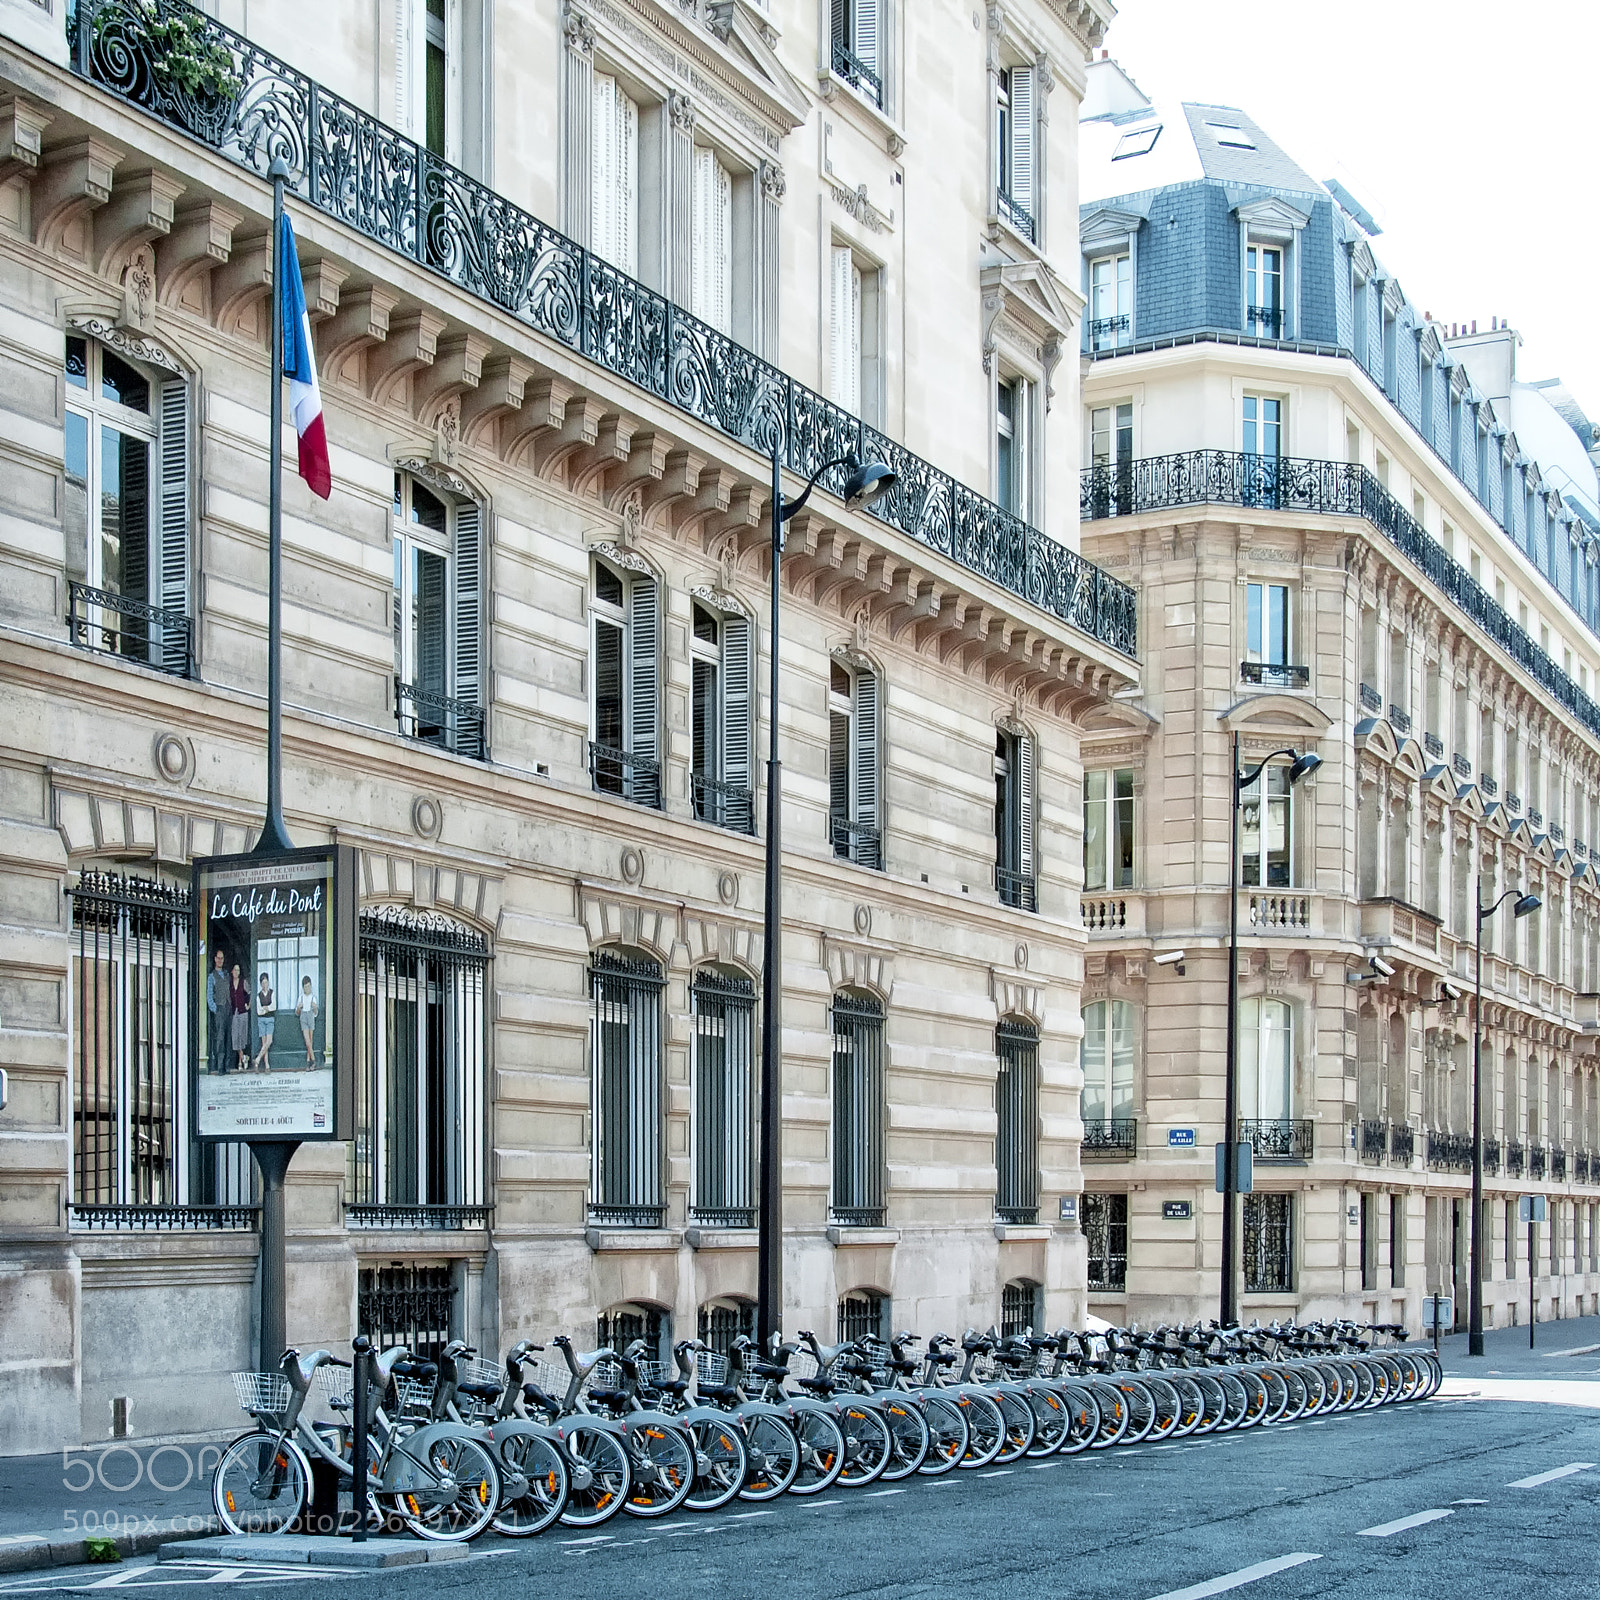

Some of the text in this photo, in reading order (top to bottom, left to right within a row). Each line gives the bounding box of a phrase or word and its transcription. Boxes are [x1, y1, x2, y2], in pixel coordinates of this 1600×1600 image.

[210, 884, 322, 923] Le Café du Pont
[235, 1117, 260, 1126] SORTIE
[261, 1117, 269, 1125] LE
[277, 1115, 294, 1125] AOÛT
